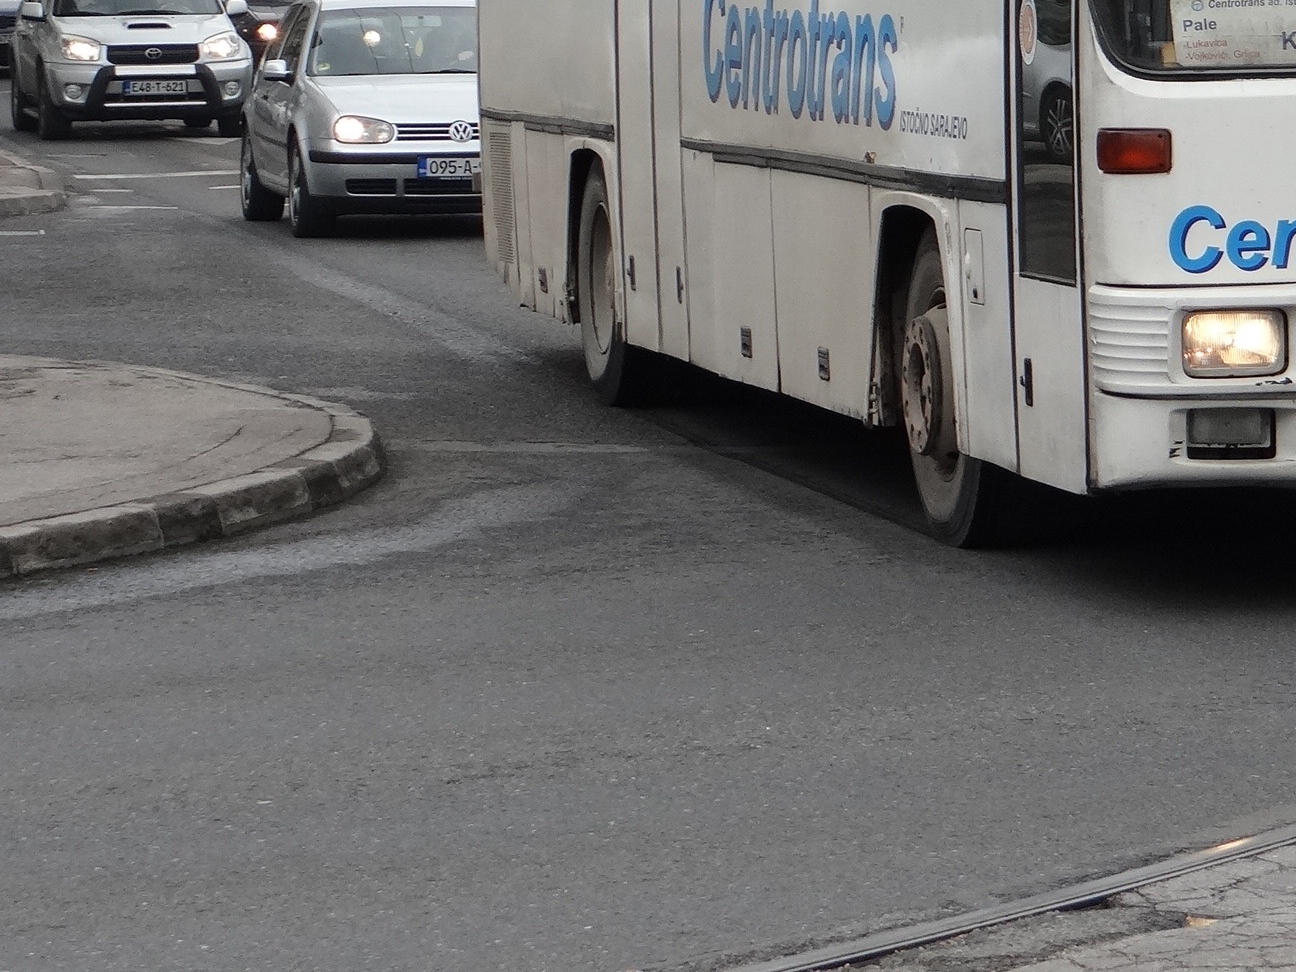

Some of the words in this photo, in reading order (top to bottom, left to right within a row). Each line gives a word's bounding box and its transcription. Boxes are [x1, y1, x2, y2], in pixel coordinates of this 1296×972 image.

[1182, 18, 1217, 32] Pale
[930, 113, 968, 140] SARAJEVO
[430, 160, 481, 174] 095-A-
